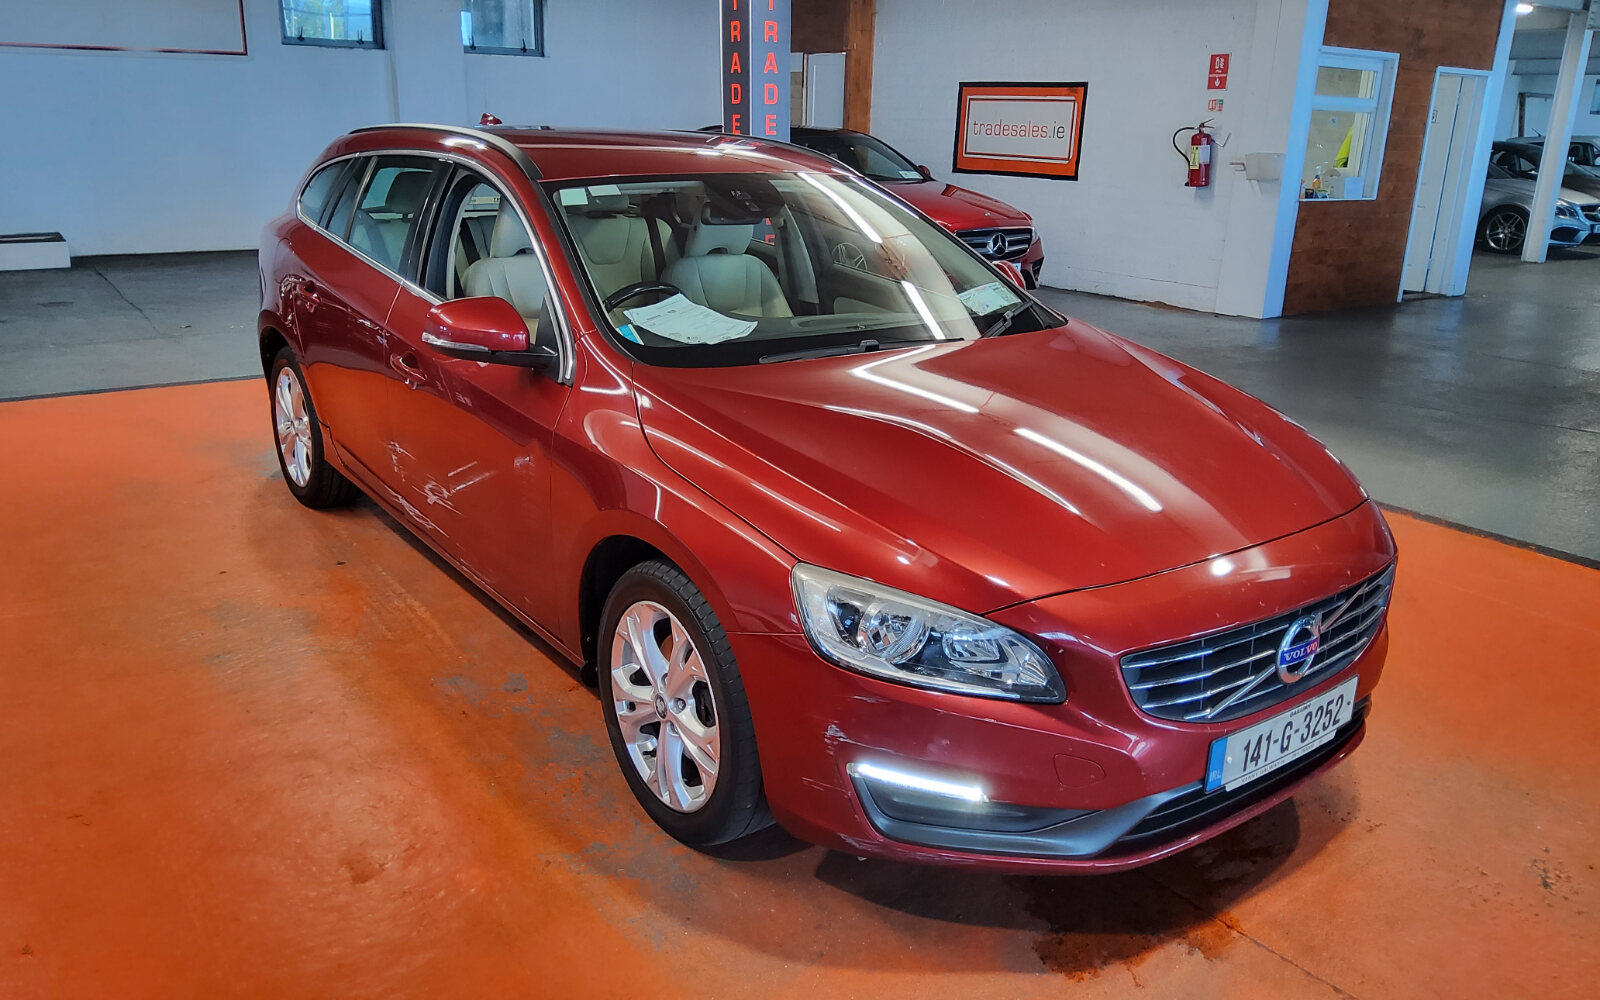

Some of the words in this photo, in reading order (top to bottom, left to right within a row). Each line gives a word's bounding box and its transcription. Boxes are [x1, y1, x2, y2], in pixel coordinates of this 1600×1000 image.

[973, 119, 1065, 139] tradesales.ie
[1284, 641, 1318, 661] VOLVO
[1242, 694, 1345, 773] 141-G-3252
[1209, 769, 1222, 783] IRL
